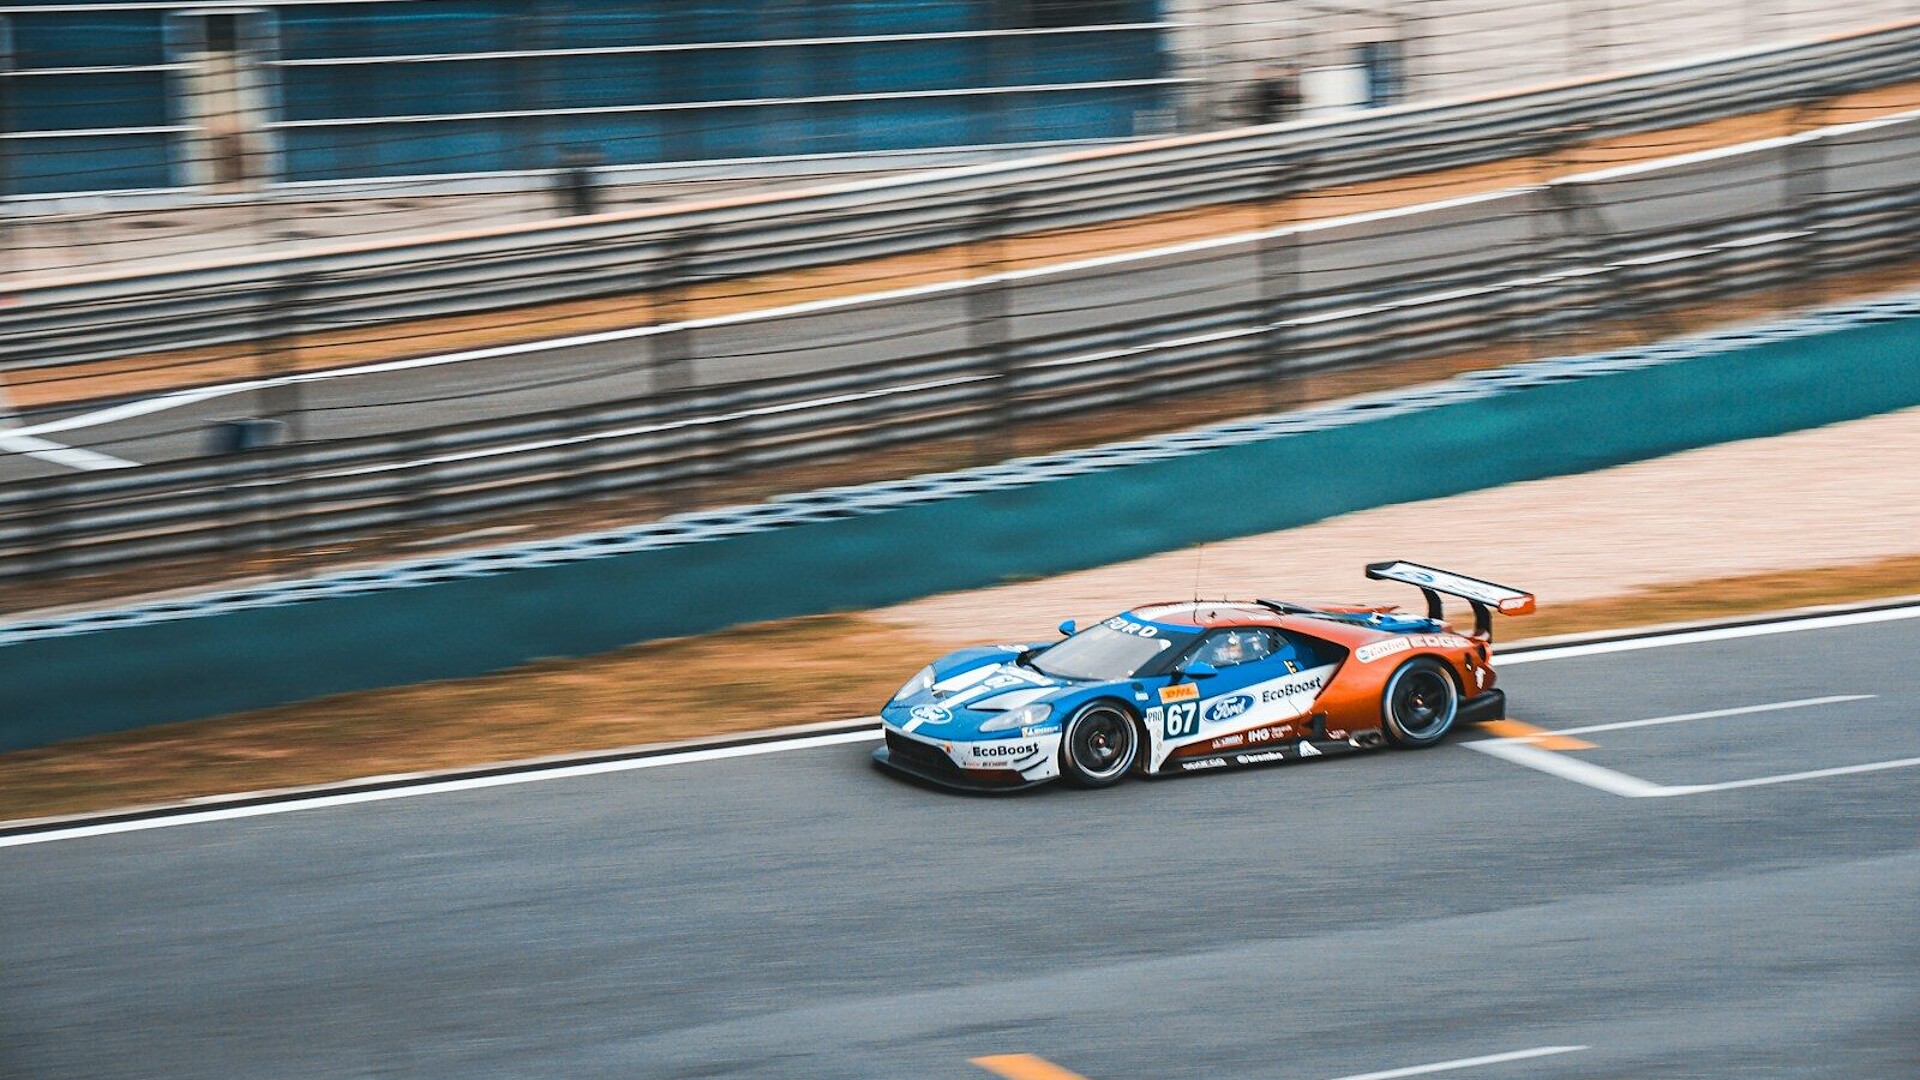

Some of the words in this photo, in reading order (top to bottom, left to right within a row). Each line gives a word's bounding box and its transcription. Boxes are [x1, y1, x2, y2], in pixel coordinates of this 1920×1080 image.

[1261, 677, 1321, 703] EcoBoost
[1147, 711, 1163, 723] PRO
[1167, 702, 1197, 736] 67
[1212, 697, 1246, 721] Ford
[1248, 727, 1270, 743] IHG
[972, 742, 1039, 757] EcoBoost
